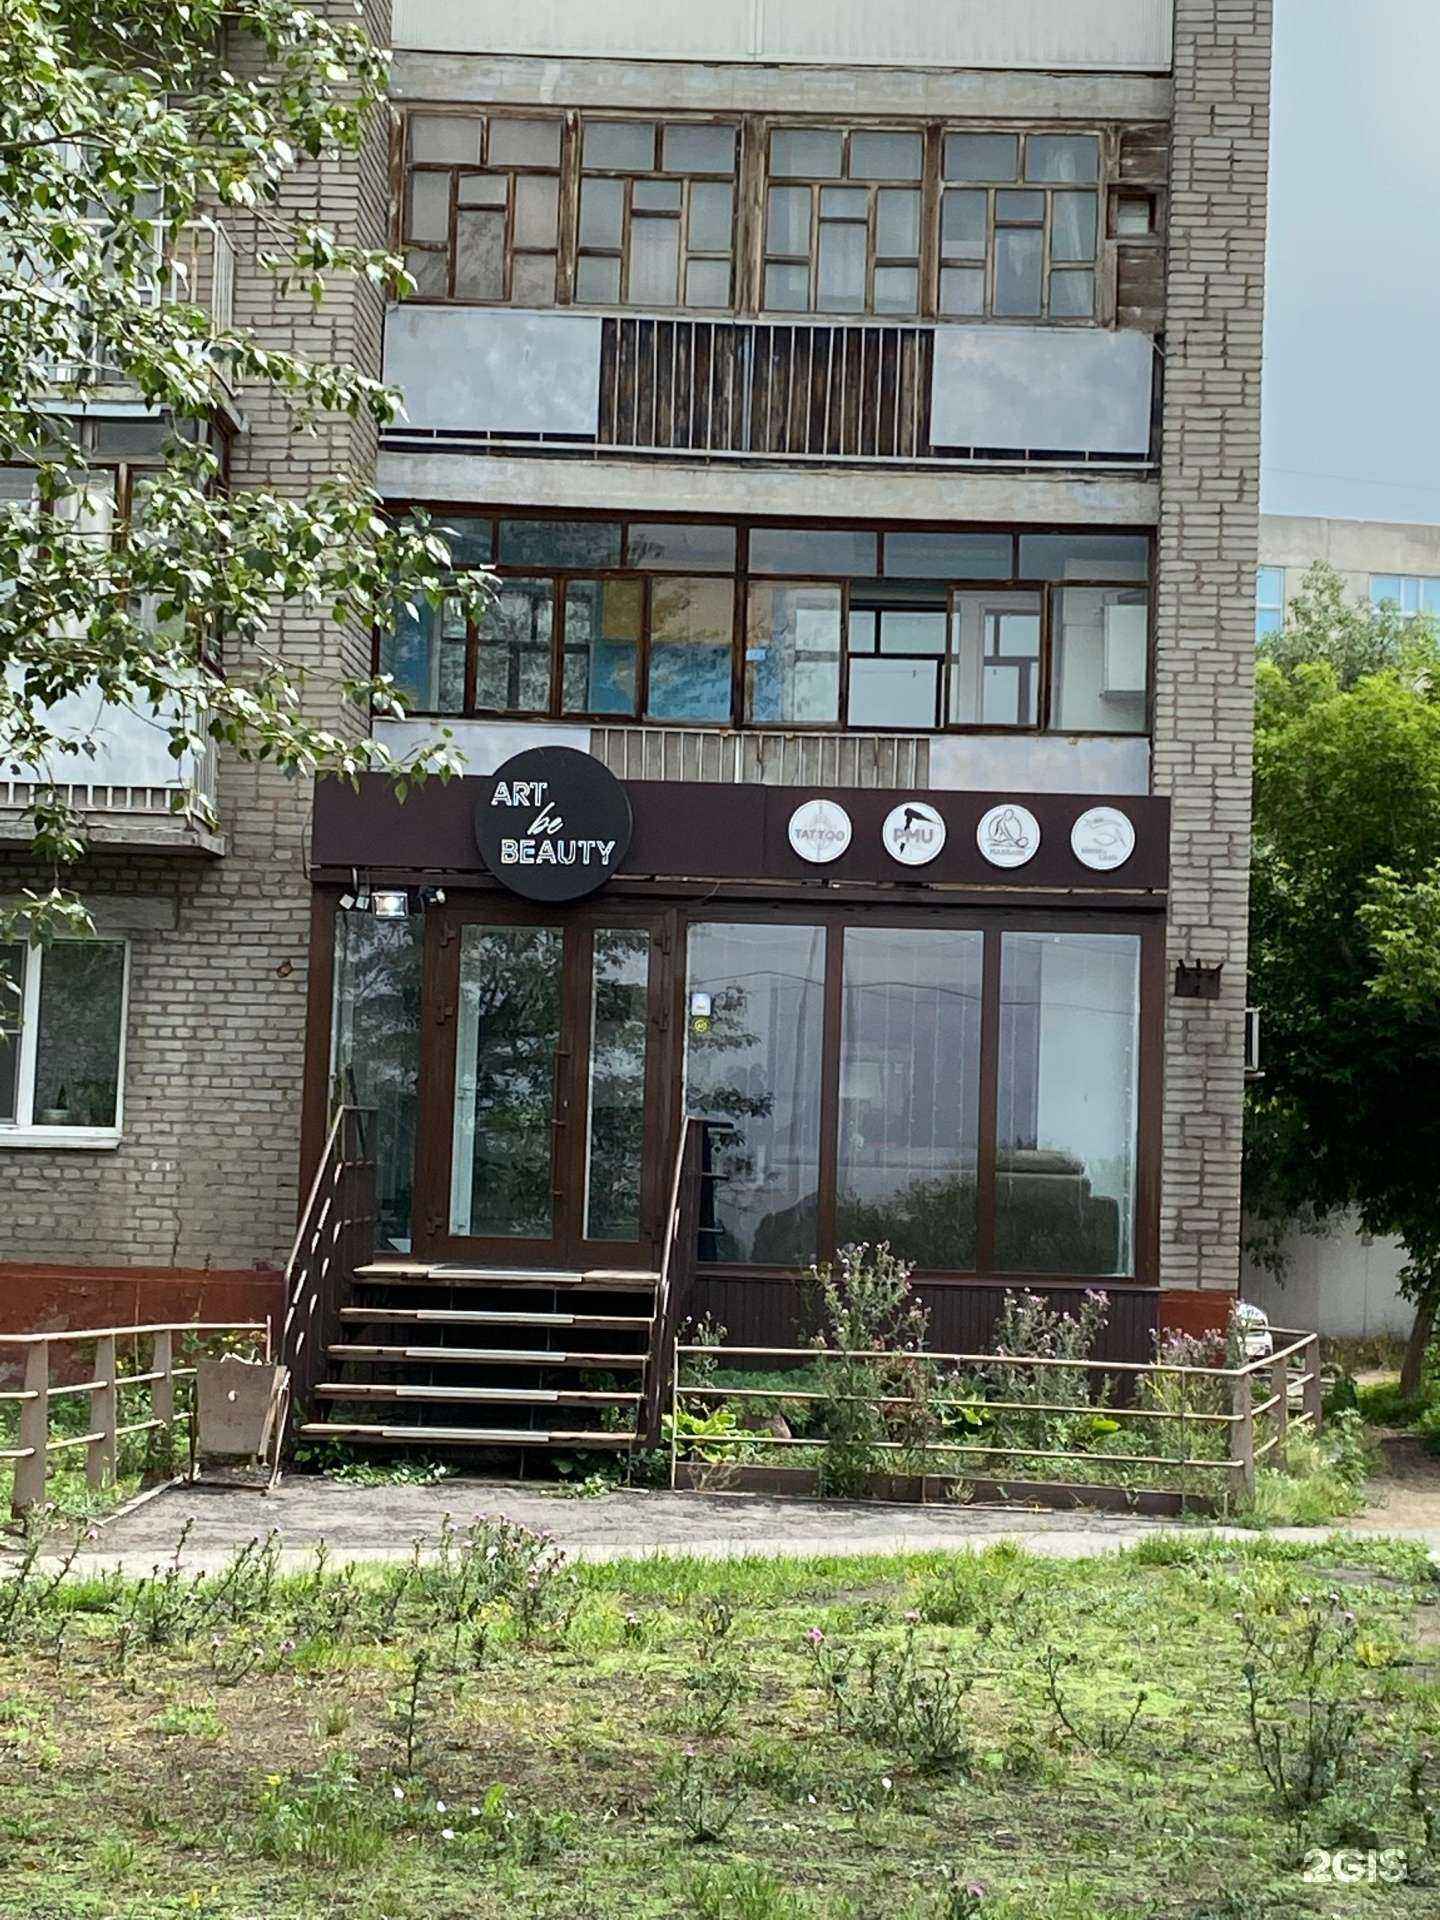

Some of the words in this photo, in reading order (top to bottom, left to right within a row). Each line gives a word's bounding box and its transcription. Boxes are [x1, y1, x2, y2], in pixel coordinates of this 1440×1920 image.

[491, 781, 548, 807] ART
[527, 802, 564, 835] be
[794, 828, 846, 842] TATTOO
[893, 828, 934, 844] PMU
[501, 839, 616, 865] BEAUTY
